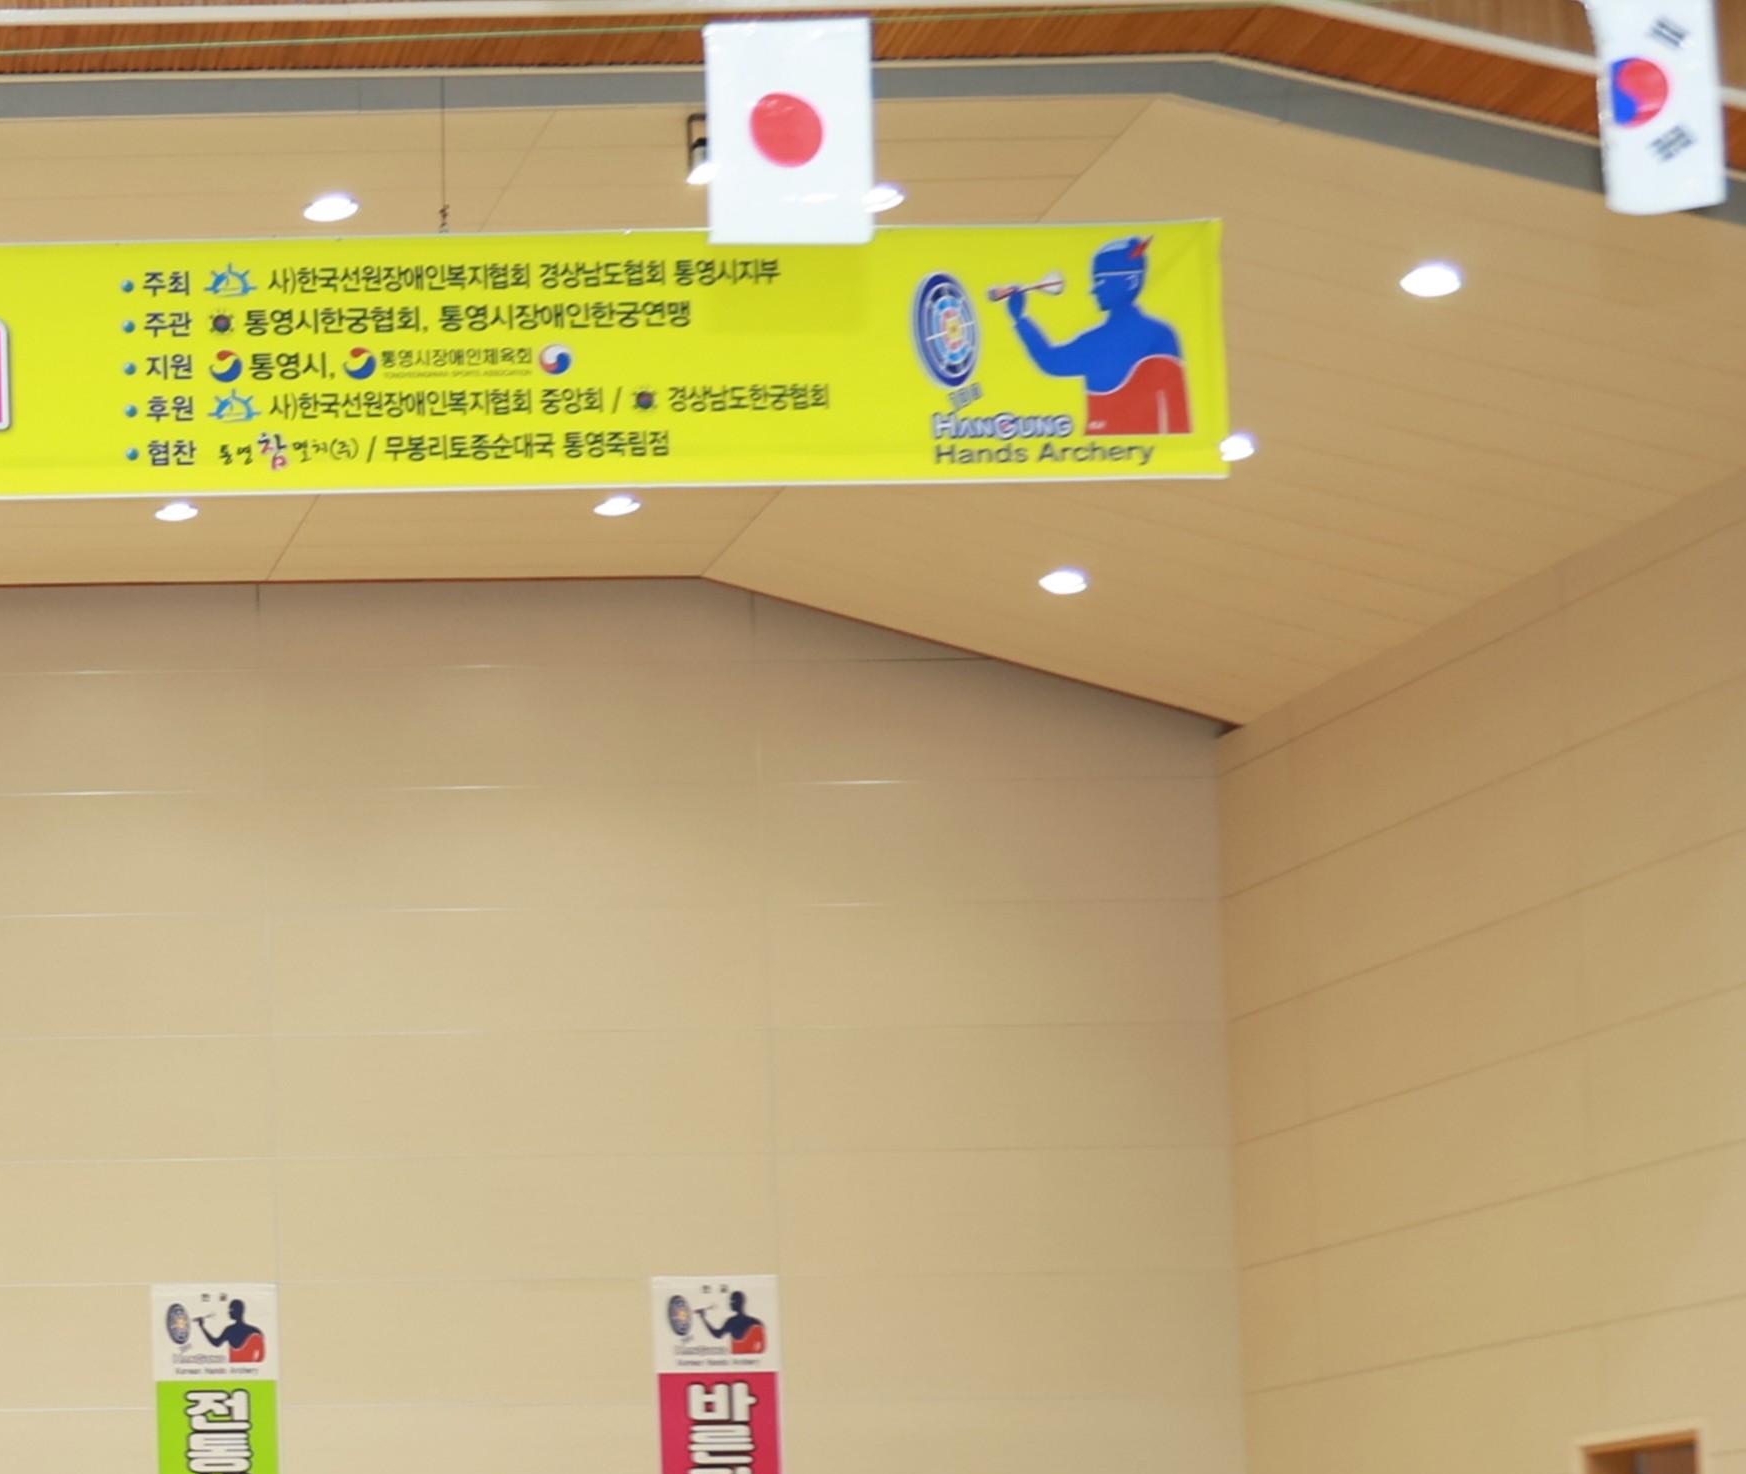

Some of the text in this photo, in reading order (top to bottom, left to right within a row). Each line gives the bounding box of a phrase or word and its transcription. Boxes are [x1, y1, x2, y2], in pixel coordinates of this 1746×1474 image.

[142, 257, 781, 297] 주최 사)한국선원장애인복지협회 경상남도협회 통영시지부
[143, 299, 692, 338] 주관 통영시한궁협회, 통영시장애인한궁연맹
[145, 346, 532, 381] 지원 통영시, 통영시장애인체육회
[146, 394, 194, 422] 후원
[269, 387, 532, 421] 사)한국선원장애인복지협회
[540, 386, 604, 415] 중앙회
[668, 383, 830, 412] 경상남도한궁협회
[147, 439, 196, 467] 협찬
[385, 432, 555, 461] 무봉리토종순대국
[563, 430, 670, 458] 통영죽림점
[935, 439, 1154, 466] Hands Archery
